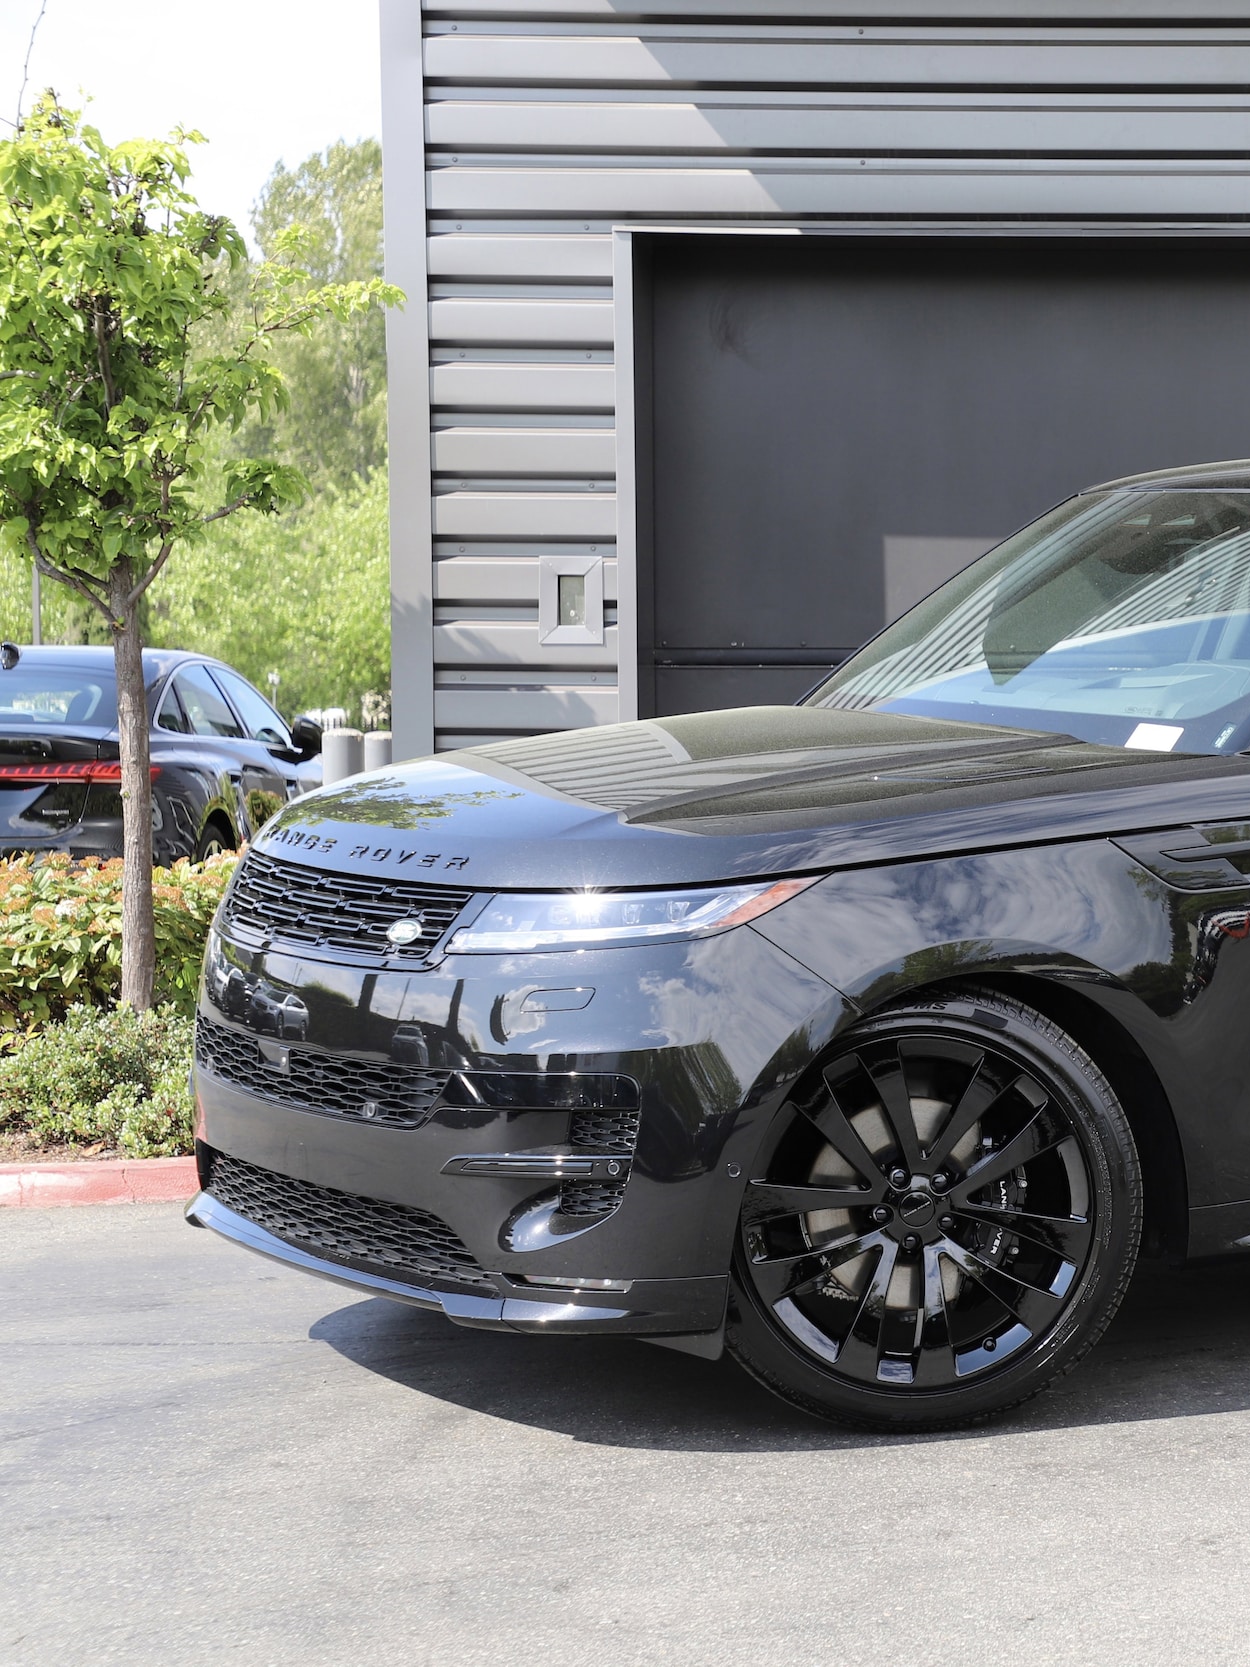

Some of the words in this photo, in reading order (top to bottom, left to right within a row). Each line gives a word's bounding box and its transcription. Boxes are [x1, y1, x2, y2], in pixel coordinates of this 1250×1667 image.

[264, 824, 338, 853] RANGE
[349, 845, 470, 871] ROVER
[990, 1227, 1003, 1255] VER
